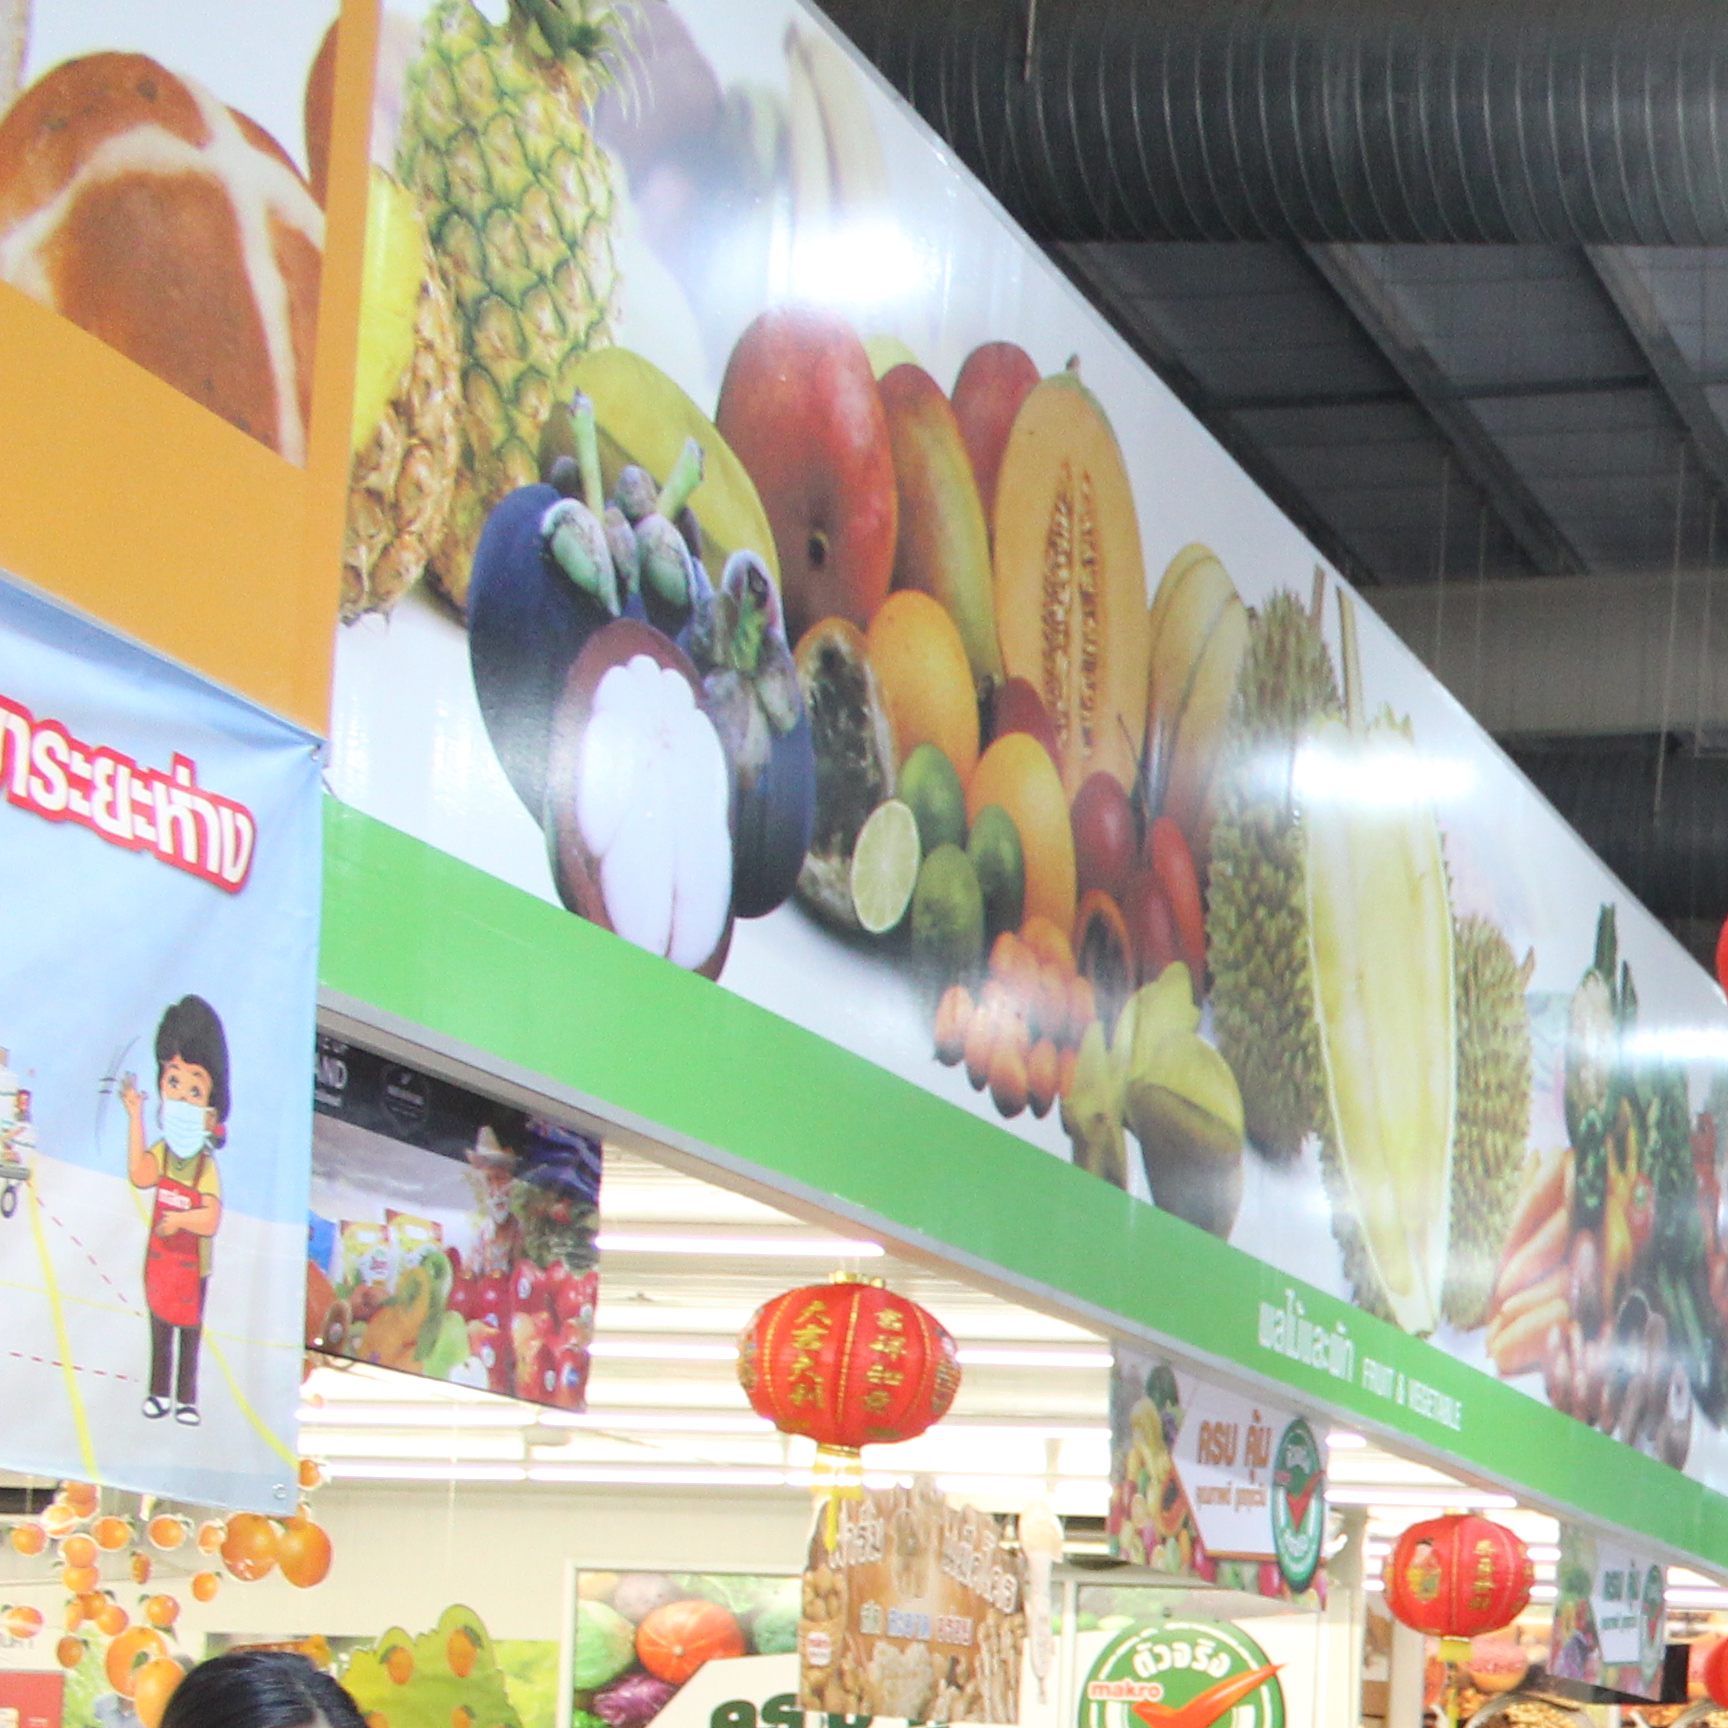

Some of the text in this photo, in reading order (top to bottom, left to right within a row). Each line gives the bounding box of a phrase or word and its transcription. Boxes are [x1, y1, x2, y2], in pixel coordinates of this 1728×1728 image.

[0, 708, 255, 884] าระยะห่าง
[1133, 1638, 1231, 1679] ตัวจริง
[1091, 1679, 1162, 1698] makro
